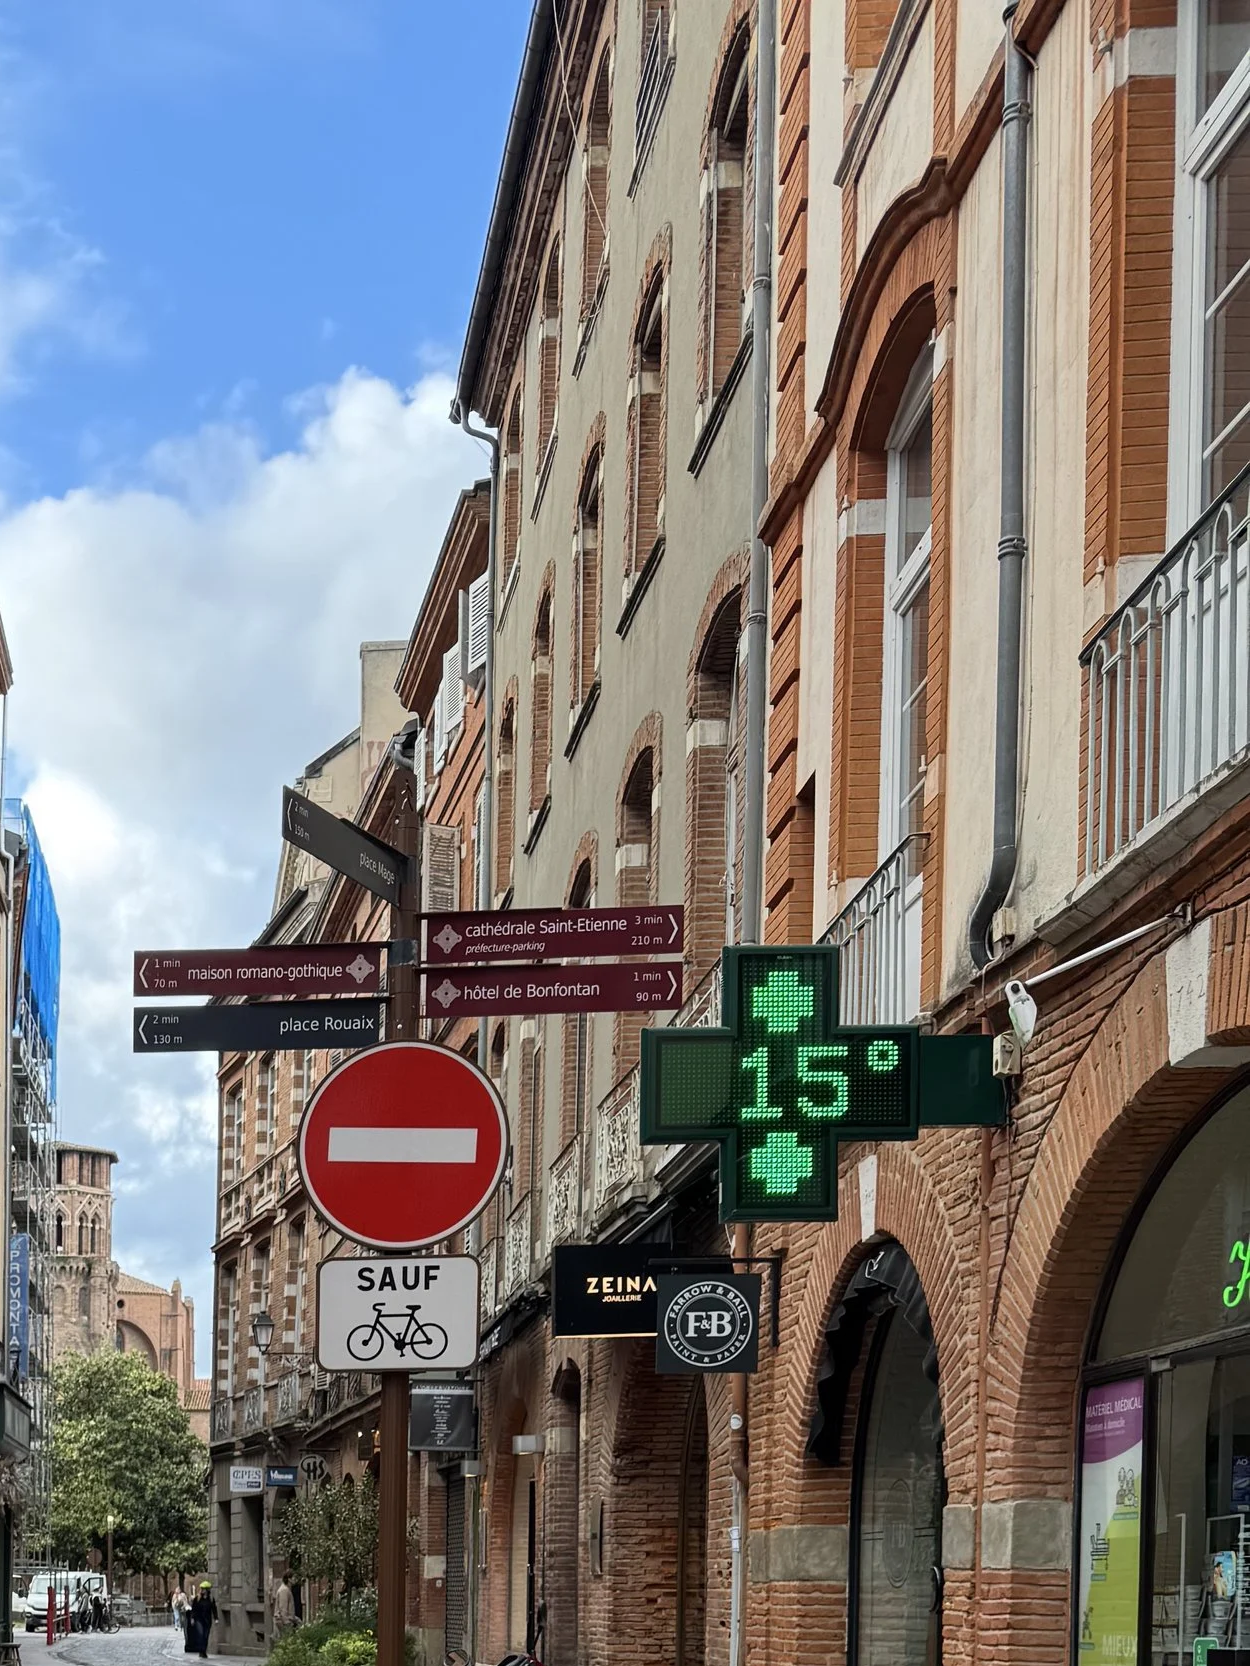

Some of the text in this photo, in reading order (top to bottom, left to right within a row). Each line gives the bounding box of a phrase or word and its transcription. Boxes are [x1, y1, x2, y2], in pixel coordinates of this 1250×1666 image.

[294, 801, 309, 818] 2 min
[294, 824, 304, 837] 150
[359, 852, 395, 885] place Mage
[465, 917, 628, 938] cathédrale Saint-Etienne
[634, 914, 663, 925] 3 min
[465, 940, 546, 955] préfecture-parking
[631, 936, 663, 946] 210 m
[154, 958, 181, 968] 1 min
[187, 962, 343, 982] maison romano-gothique
[634, 972, 662, 982] 1 min
[154, 979, 178, 989] 70 m
[464, 983, 600, 1001] hôtel de Bonfontan
[635, 992, 662, 1002] 90 m
[153, 1014, 180, 1025] 2 min
[279, 1016, 375, 1035] place Rouaix
[153, 1035, 183, 1044] 130 m
[357, 1264, 440, 1292] SAUF
[586, 1276, 657, 1294] ZEINA
[602, 1294, 642, 1303] JOAILLERIE
[669, 1285, 748, 1319] FARROW & BALL
[685, 1310, 732, 1338] F&B
[670, 1333, 698, 1361] PAINT
[717, 1334, 747, 1361] PAPER
[1085, 1396, 1142, 1418] MATÉRIEL MÉDICAL
[1102, 1634, 1137, 1657] MIEUX
